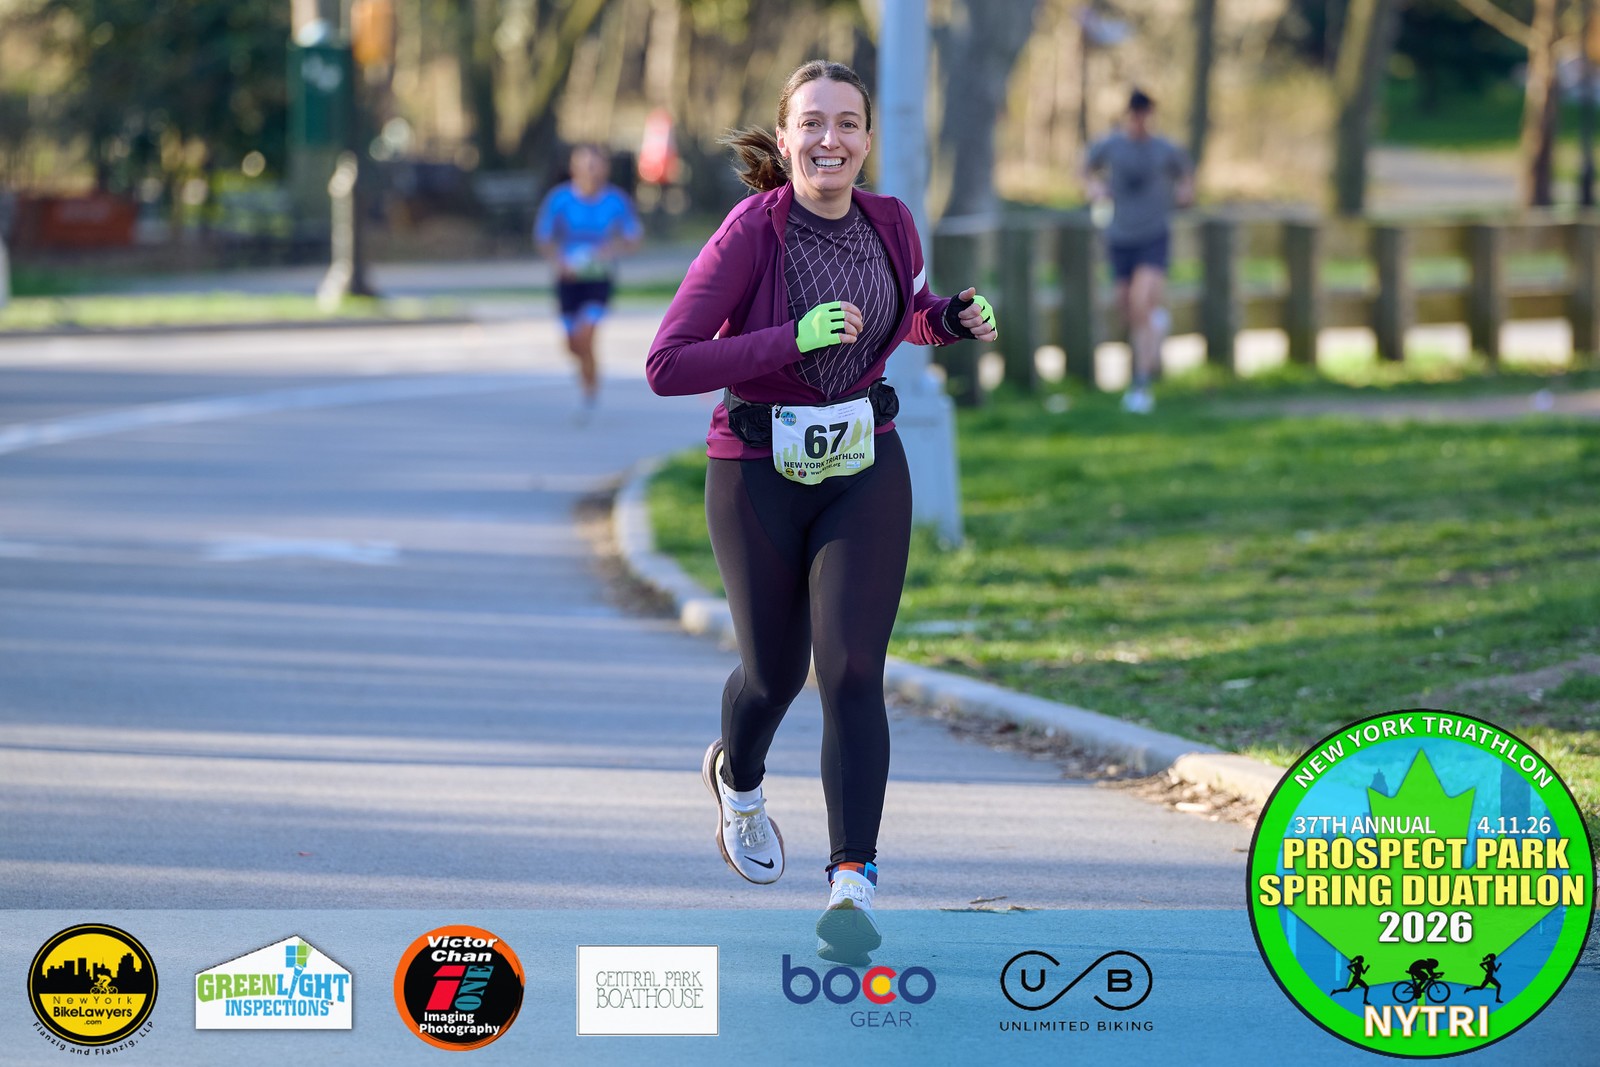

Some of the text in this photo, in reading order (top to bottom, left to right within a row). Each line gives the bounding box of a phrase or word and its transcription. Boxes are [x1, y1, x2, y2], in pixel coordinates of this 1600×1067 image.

[804, 421, 849, 459] 67
[784, 461, 803, 469] NEW
[804, 460, 825, 469] YORK
[825, 452, 865, 465] TRIATHLON
